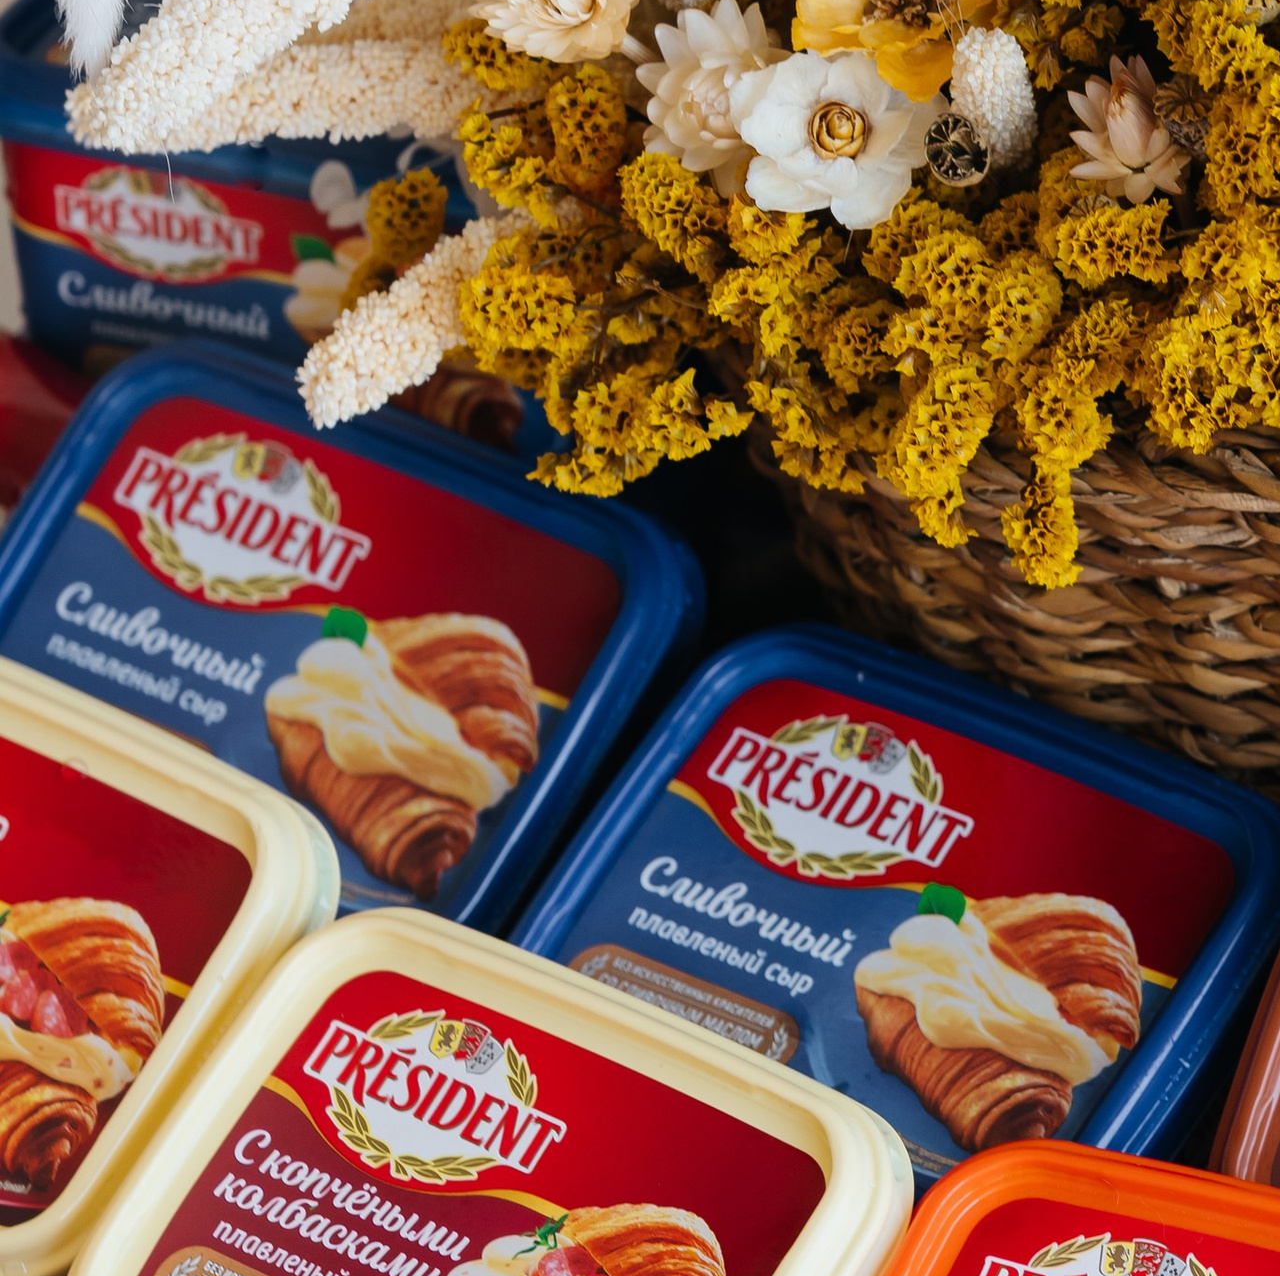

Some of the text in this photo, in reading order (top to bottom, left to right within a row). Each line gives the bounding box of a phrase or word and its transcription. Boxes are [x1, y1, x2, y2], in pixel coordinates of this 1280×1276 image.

[62, 193, 259, 260] PRÉSIDENT
[57, 270, 270, 340] Сливочный
[122, 456, 366, 585] PRÉSIDENT
[47, 634, 227, 725] плавленый сыр
[56, 582, 267, 693] Сливочный
[715, 735, 969, 863] PRÉSIDENT
[628, 907, 814, 997] плавленый сыр
[640, 856, 856, 967] Сливочный
[309, 1026, 563, 1171] PRÉSIDENT
[234, 1128, 470, 1261] С копчёными
[203, 1261, 221, 1276] БЕЗ
